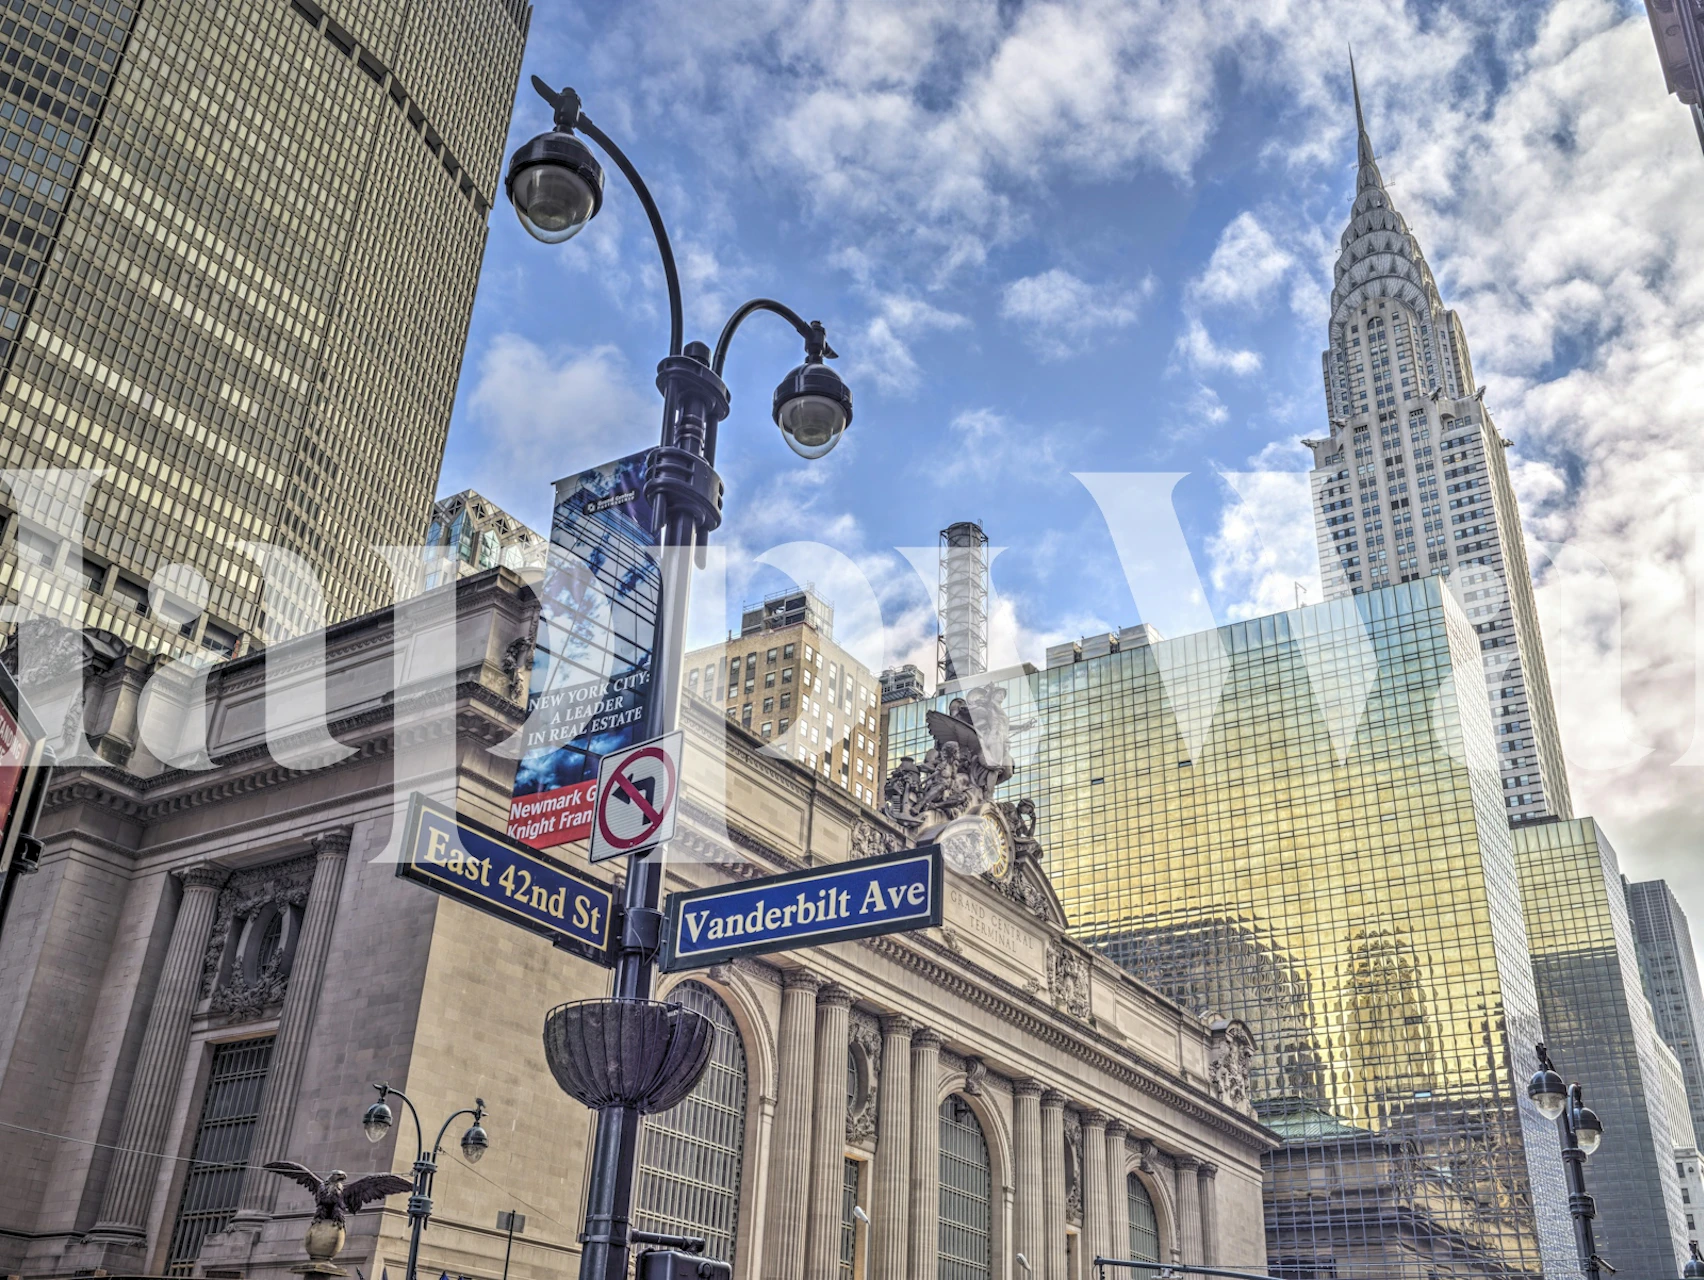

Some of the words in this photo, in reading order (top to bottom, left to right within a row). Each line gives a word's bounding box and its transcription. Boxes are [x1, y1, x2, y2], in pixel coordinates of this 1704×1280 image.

[528, 693, 562, 713] NEW
[568, 683, 609, 704] YORK
[613, 671, 651, 693] CITY:
[551, 712, 561, 725] A
[566, 697, 623, 722] LEADER
[527, 732, 547, 746] IN
[549, 722, 587, 742] REAL
[590, 706, 643, 732] ESTATE
[507, 816, 556, 840] Knight
[559, 808, 593, 830] Fran
[510, 789, 582, 821] Newmark
[424, 825, 492, 888] East
[498, 863, 565, 919] 42nd
[572, 896, 601, 936] St
[685, 887, 850, 944] Vanderbilt
[860, 878, 926, 915] Ave
[950, 890, 985, 919] GRAND
[990, 915, 1034, 950] CENTRAL
[969, 915, 1017, 953] TERMINAL
